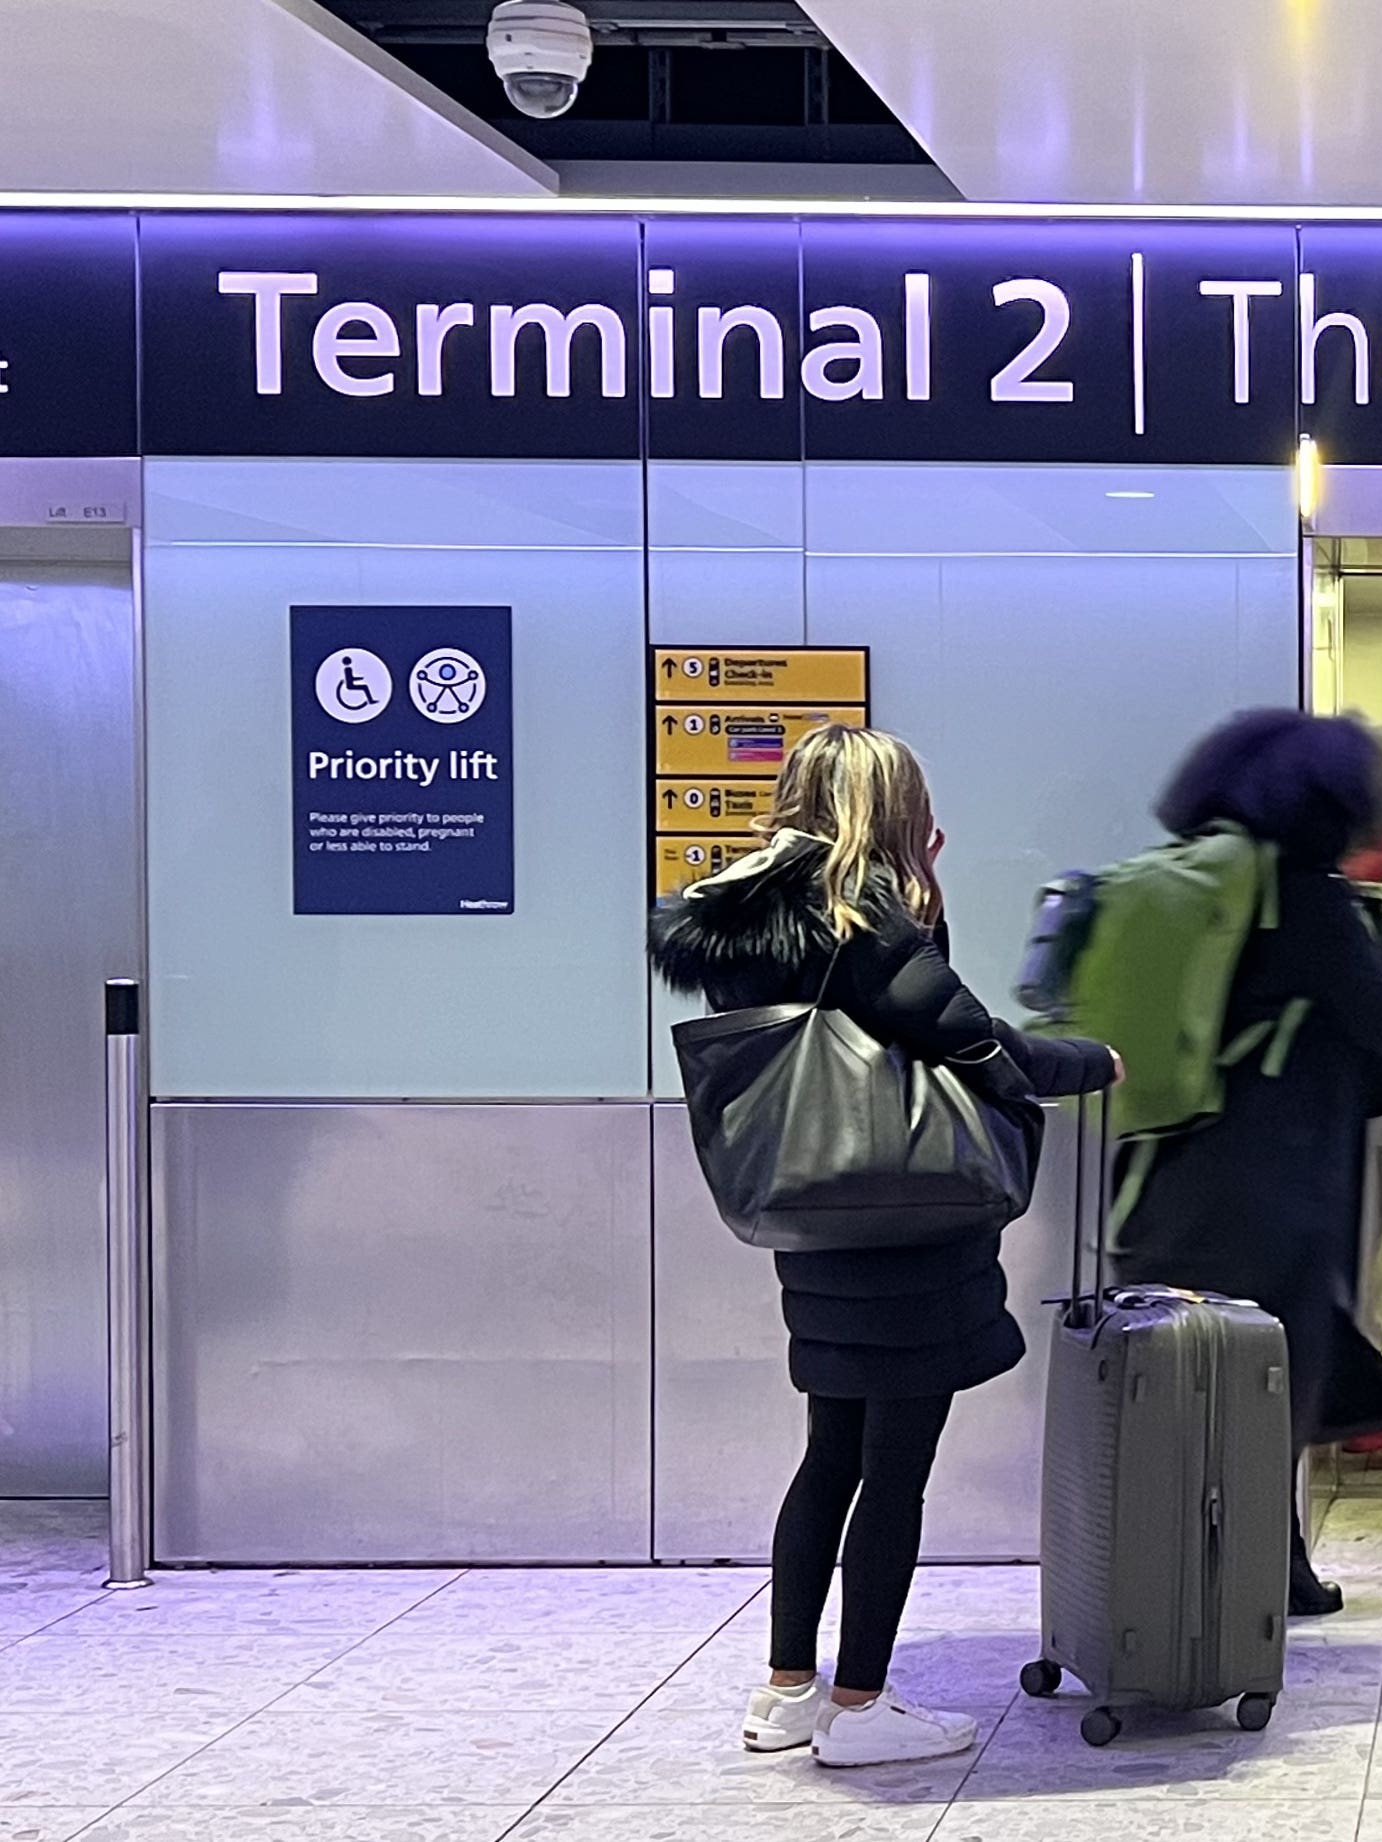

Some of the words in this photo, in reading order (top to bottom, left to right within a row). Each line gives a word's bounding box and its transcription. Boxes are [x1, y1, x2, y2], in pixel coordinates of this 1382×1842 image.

[217, 268, 931, 402] Terminal
[990, 278, 1074, 402] 2
[690, 661, 698, 673] 5
[690, 719, 699, 730] 1
[308, 750, 440, 787] Priority
[449, 750, 499, 780] lift
[690, 792, 699, 805] 0
[309, 812, 348, 824] Please
[350, 812, 376, 826] give
[378, 812, 424, 826] priority
[426, 813, 440, 824] to
[442, 812, 485, 826] people
[309, 827, 338, 838] who
[339, 828, 360, 838] are
[418, 828, 475, 840] pregnant
[309, 842, 324, 852] or
[325, 841, 348, 852] less
[350, 841, 377, 852] able
[379, 841, 393, 852] to
